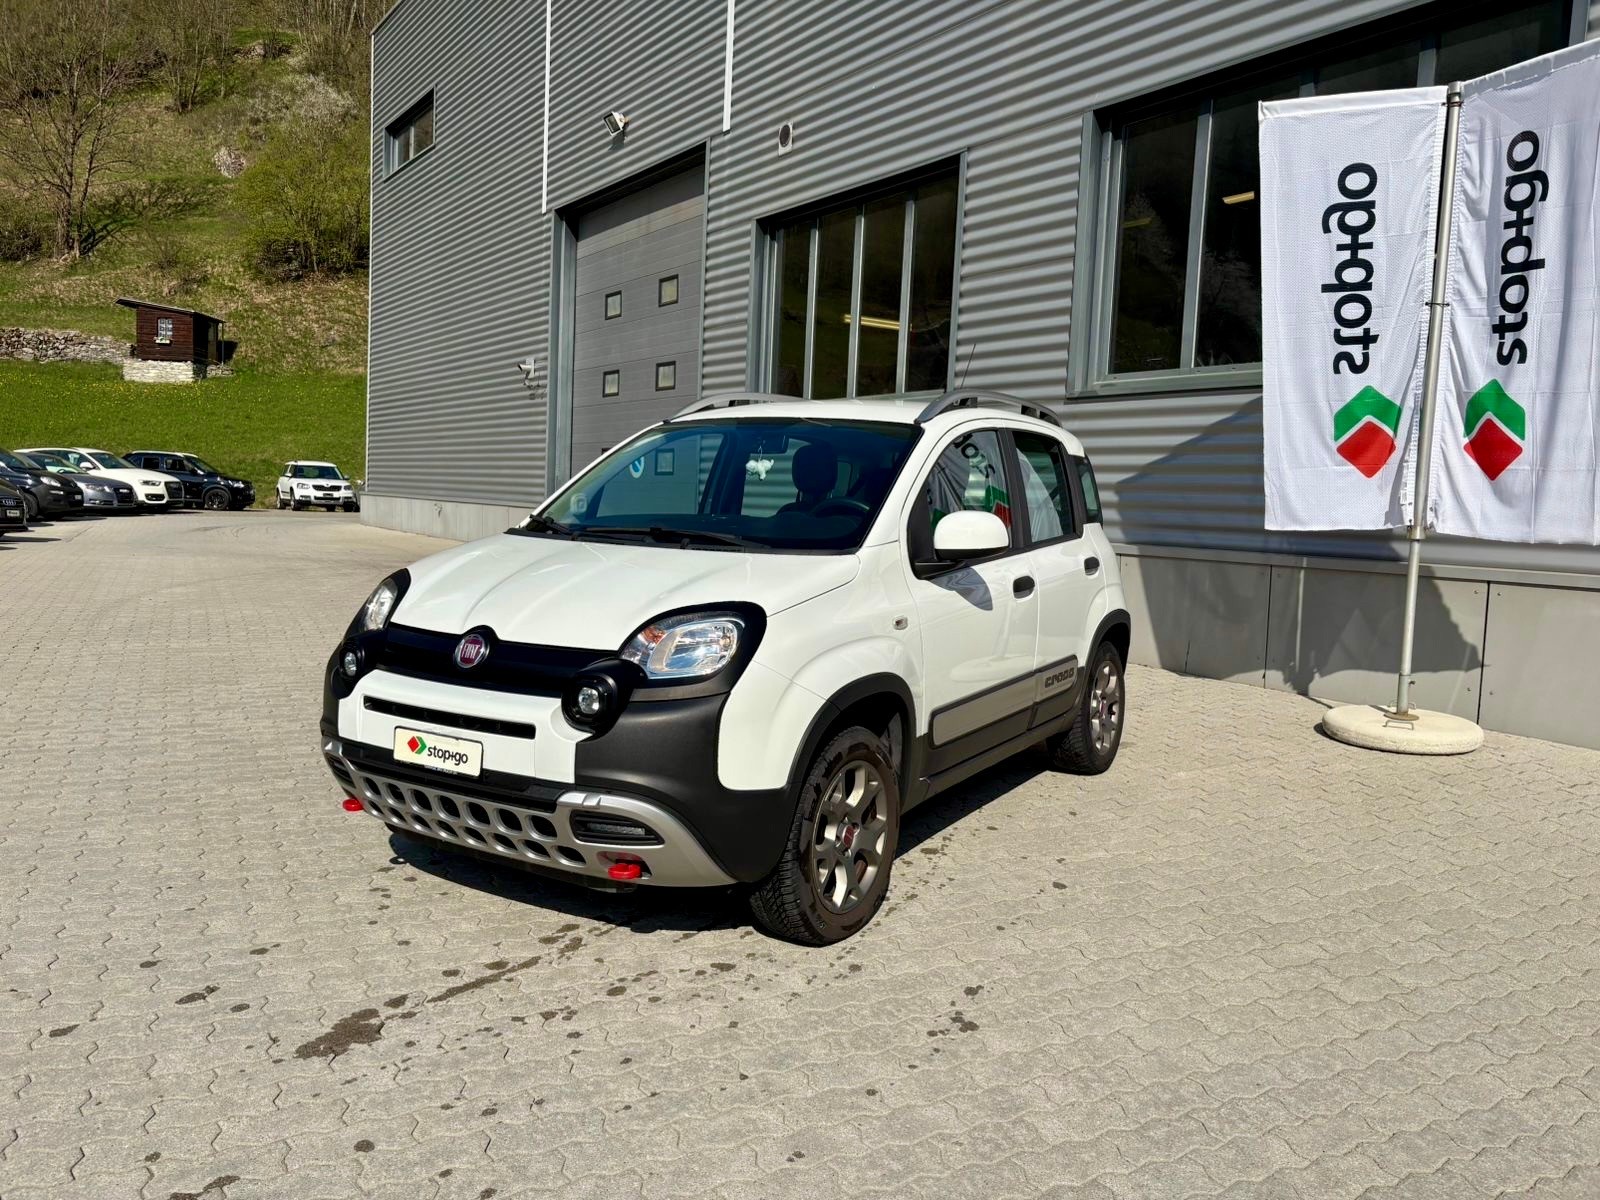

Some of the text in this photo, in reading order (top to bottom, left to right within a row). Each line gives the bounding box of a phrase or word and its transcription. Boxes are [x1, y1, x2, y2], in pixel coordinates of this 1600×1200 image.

[1492, 130, 1550, 366] stop+go
[461, 643, 480, 659] FIAT
[427, 745, 469, 766] stop+go
